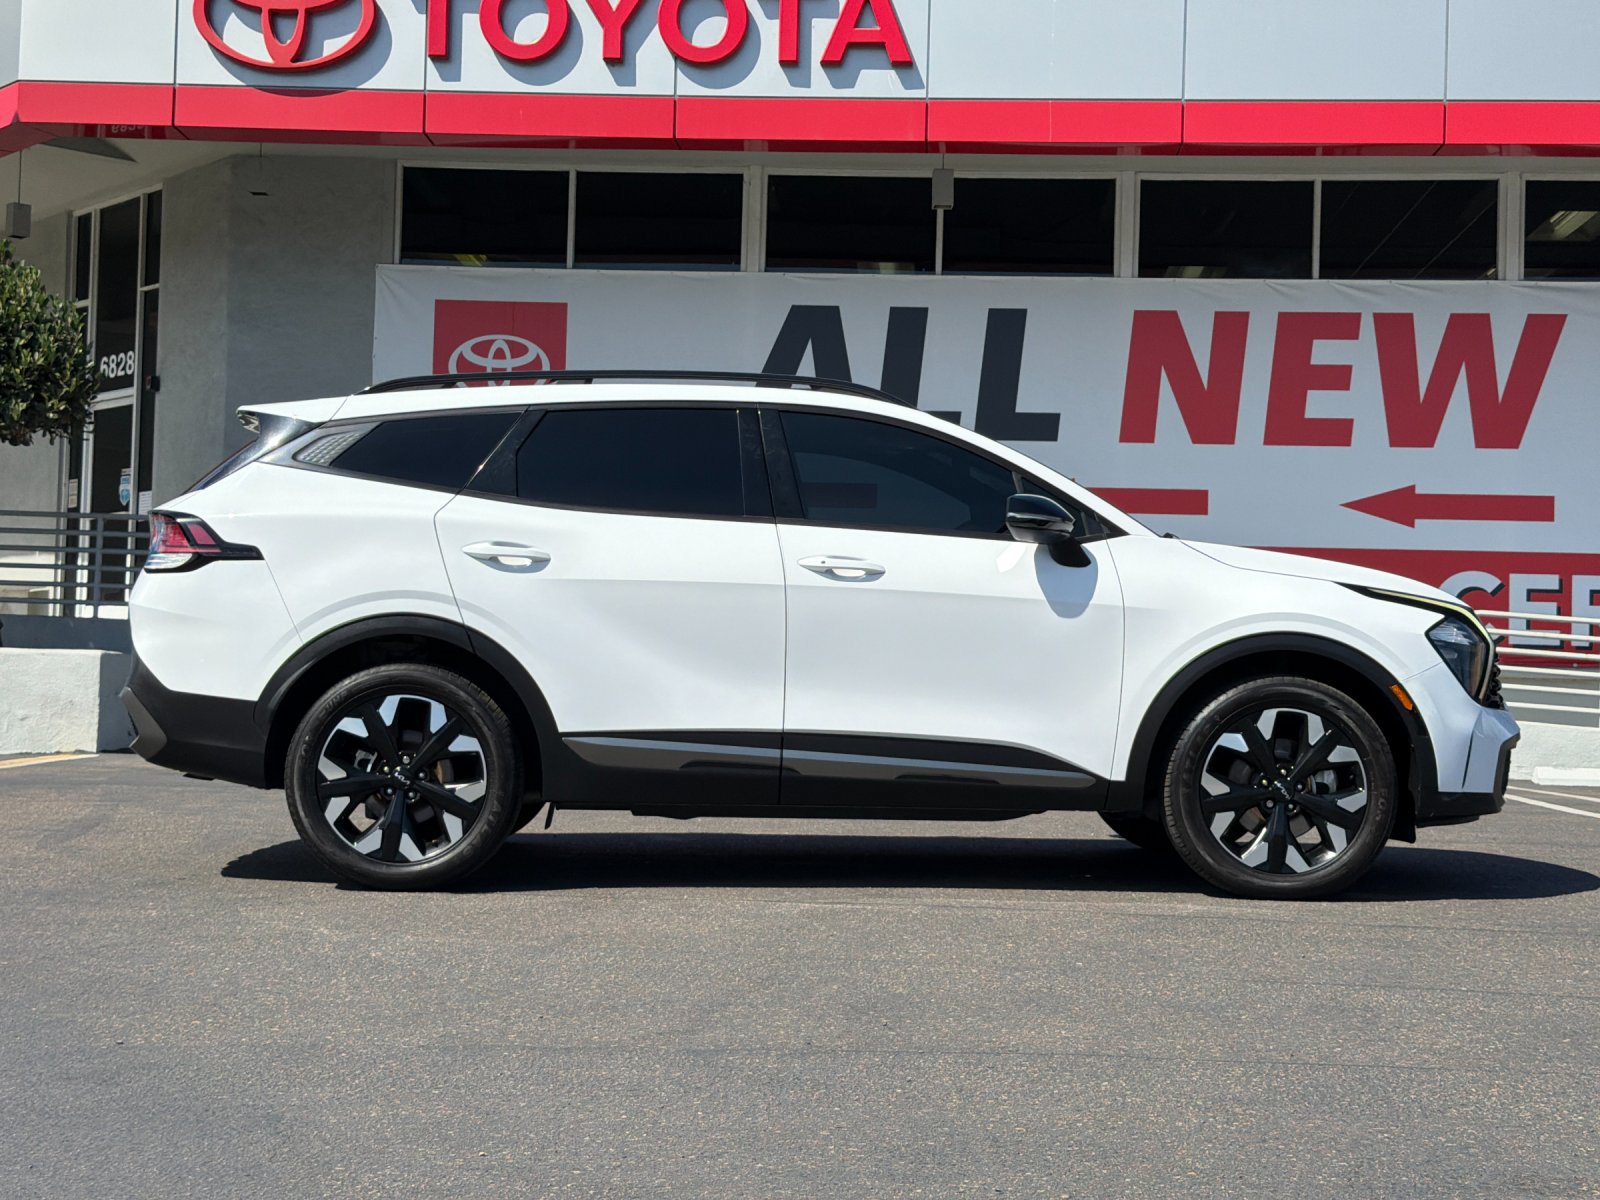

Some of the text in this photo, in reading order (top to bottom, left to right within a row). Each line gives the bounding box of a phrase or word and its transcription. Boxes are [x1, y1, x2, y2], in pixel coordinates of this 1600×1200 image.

[428, 0, 914, 65] TOYOTA
[100, 350, 135, 379] 6828
[756, 304, 1568, 449] ALL NEW
